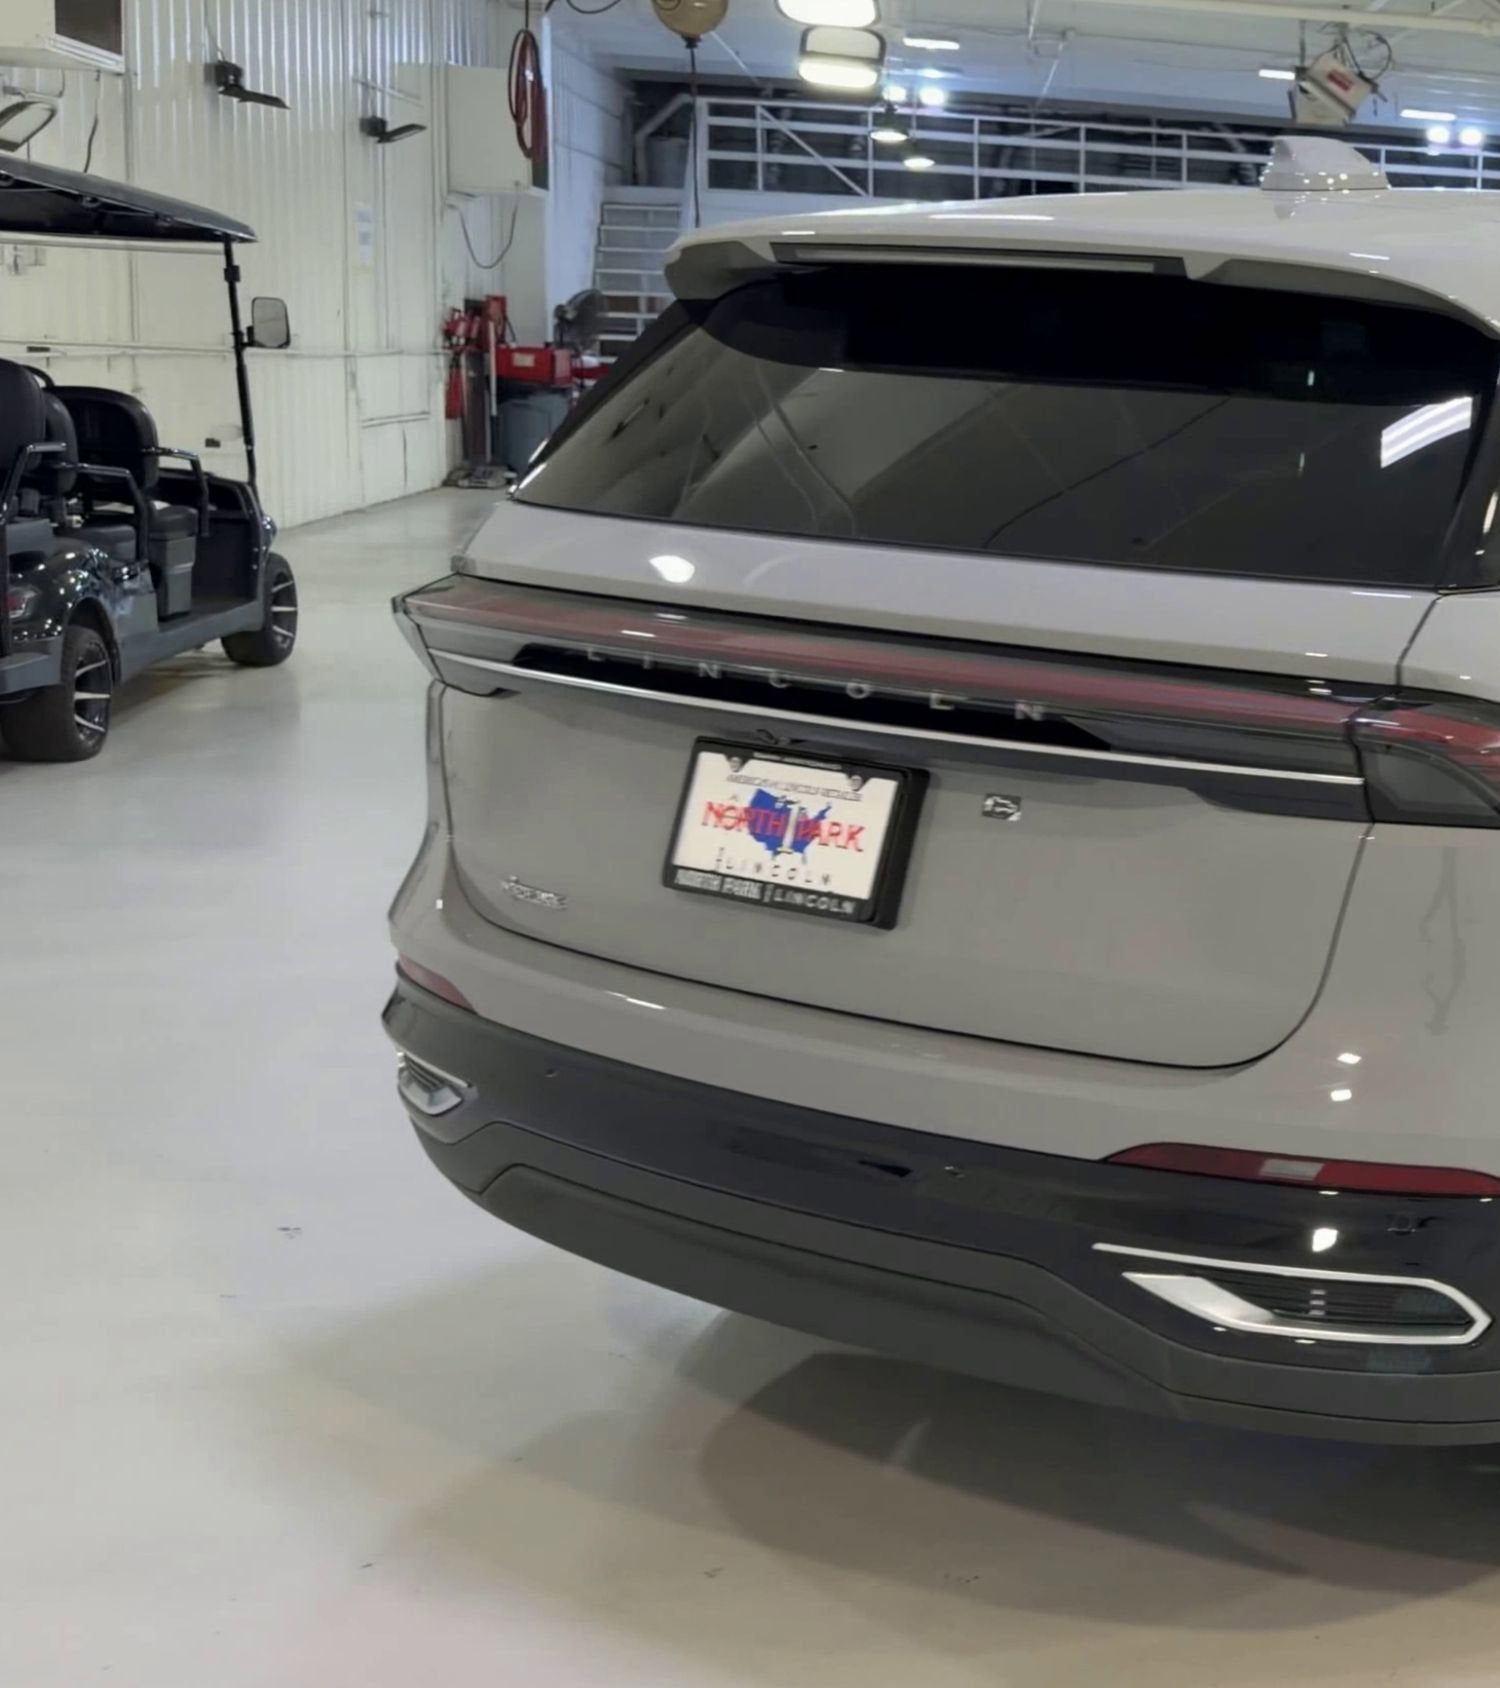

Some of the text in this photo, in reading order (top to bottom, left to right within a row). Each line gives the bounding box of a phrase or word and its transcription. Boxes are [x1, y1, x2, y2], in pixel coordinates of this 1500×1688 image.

[586, 646, 1046, 722] LINCOLN
[702, 802, 866, 852] NORTH PARK
[726, 856, 831, 885] LINCOLN
[773, 887, 857, 915] LINCOLN
